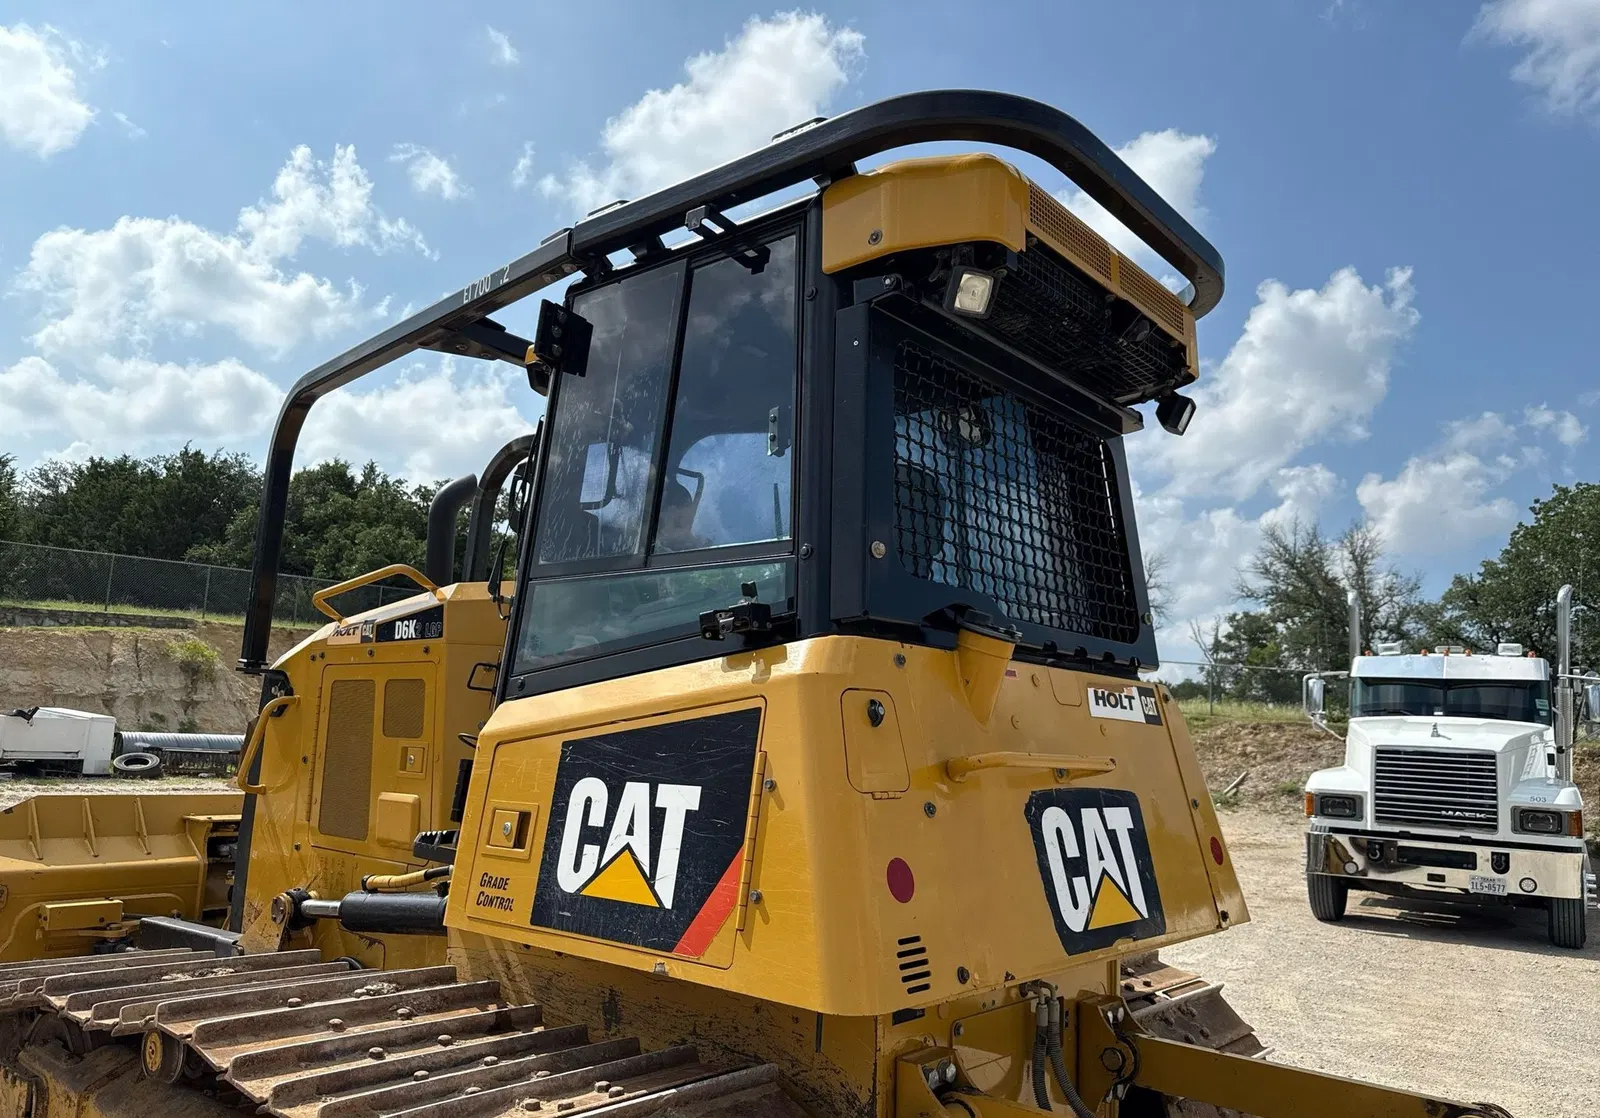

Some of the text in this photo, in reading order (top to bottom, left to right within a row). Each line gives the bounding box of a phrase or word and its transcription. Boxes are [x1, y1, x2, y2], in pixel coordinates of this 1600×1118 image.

[363, 623, 374, 637] CAT
[1093, 689, 1158, 716] HOLT CAT
[1440, 810, 1487, 819] MACK
[556, 777, 702, 910] CAT
[1041, 806, 1149, 933] CAT
[480, 872, 510, 891] GRADE
[476, 890, 514, 912] CONTROL
